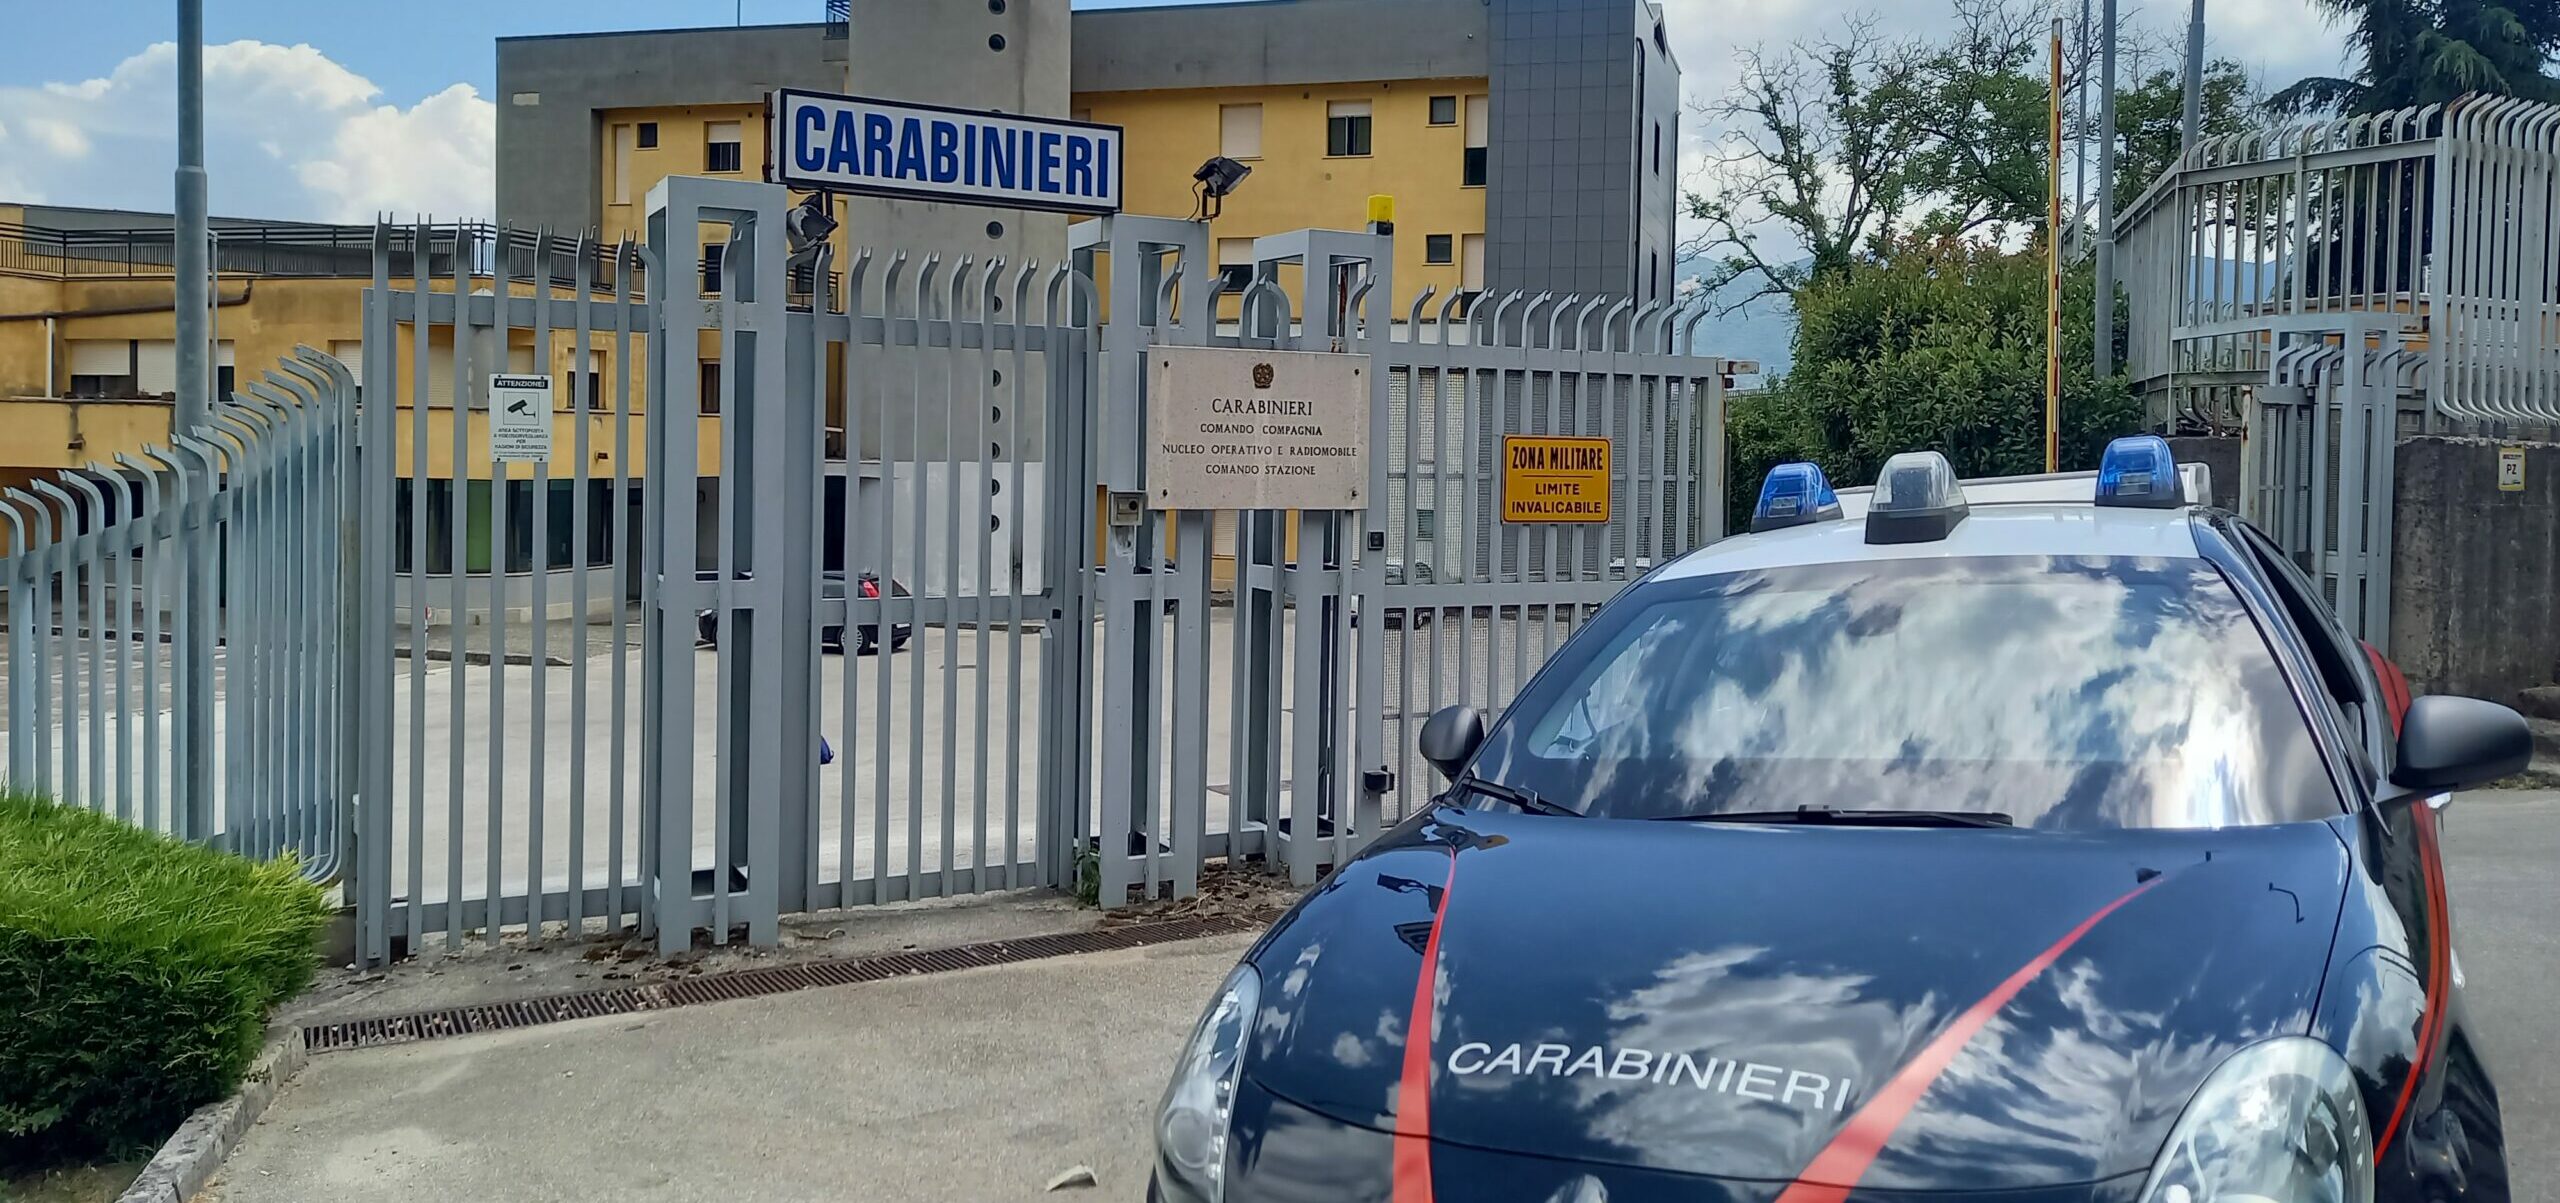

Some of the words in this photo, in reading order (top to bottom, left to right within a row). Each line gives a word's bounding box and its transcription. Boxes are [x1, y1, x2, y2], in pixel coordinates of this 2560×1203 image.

[794, 104, 1109, 199] CARABINIERI
[496, 380, 546, 388] ATTENZIONE!
[1212, 398, 1312, 416] CARABINIERI
[1200, 423, 1254, 435] COMANDO
[1262, 425, 1323, 436] COMPAGNIA
[1162, 444, 1205, 454] NUCLEO
[1211, 445, 1272, 455] OPERATIVO
[1277, 446, 1283, 455] E
[1289, 447, 1357, 457] RADIOMOBILE
[1512, 446, 1545, 469] ZONA
[1550, 446, 1603, 470] MILITARE
[1205, 464, 1259, 475] COMANDO
[1265, 465, 1316, 476] STAZIONE
[2506, 463, 2517, 475] PZ
[1535, 483, 1580, 495] LIMITE
[1511, 501, 1602, 514] INVALICABILE
[1447, 1042, 1852, 1112] CARABINIERI
